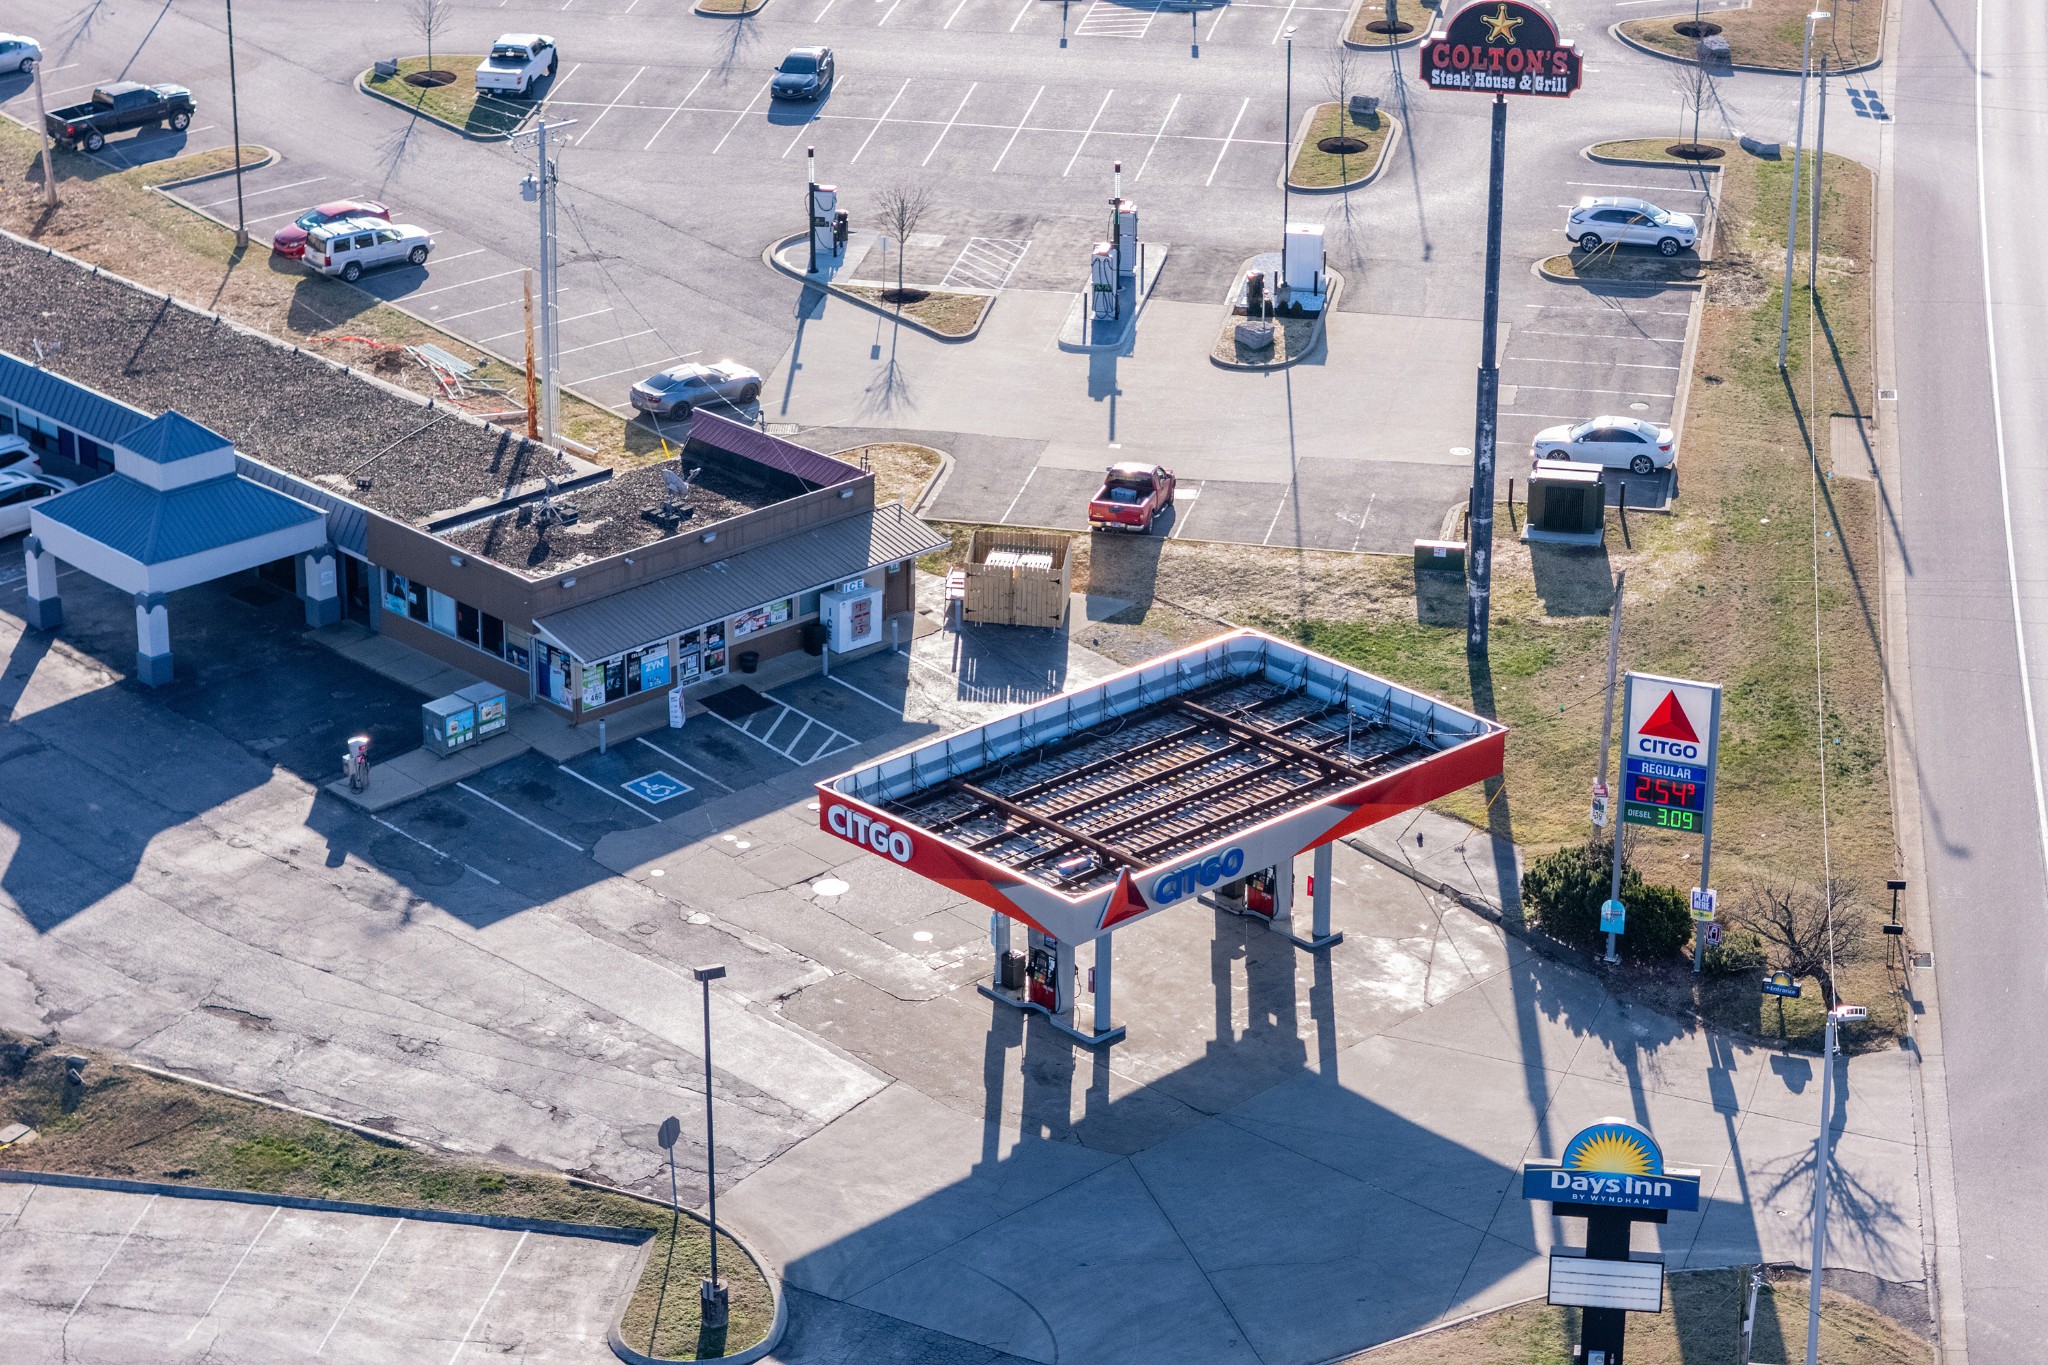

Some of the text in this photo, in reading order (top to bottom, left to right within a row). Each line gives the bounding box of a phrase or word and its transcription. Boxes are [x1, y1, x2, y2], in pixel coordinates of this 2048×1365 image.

[1432, 43, 1568, 75] COLTON'S
[1431, 69, 1567, 93] Steak House & Grill
[844, 580, 864, 593] ICE
[645, 658, 664, 672] ZYN
[1639, 738, 1698, 759] CITGO
[1641, 762, 1691, 779] REGULAR
[1627, 807, 1693, 829] DIESEL 3.09
[828, 804, 912, 862] CITGO
[1151, 847, 1244, 904] CITGO
[1694, 892, 1710, 903] PLAY
[1694, 900, 1710, 911] HERE
[1551, 1171, 1671, 1197] Days Inn
[1590, 1195, 1650, 1205] WYNDHAM
